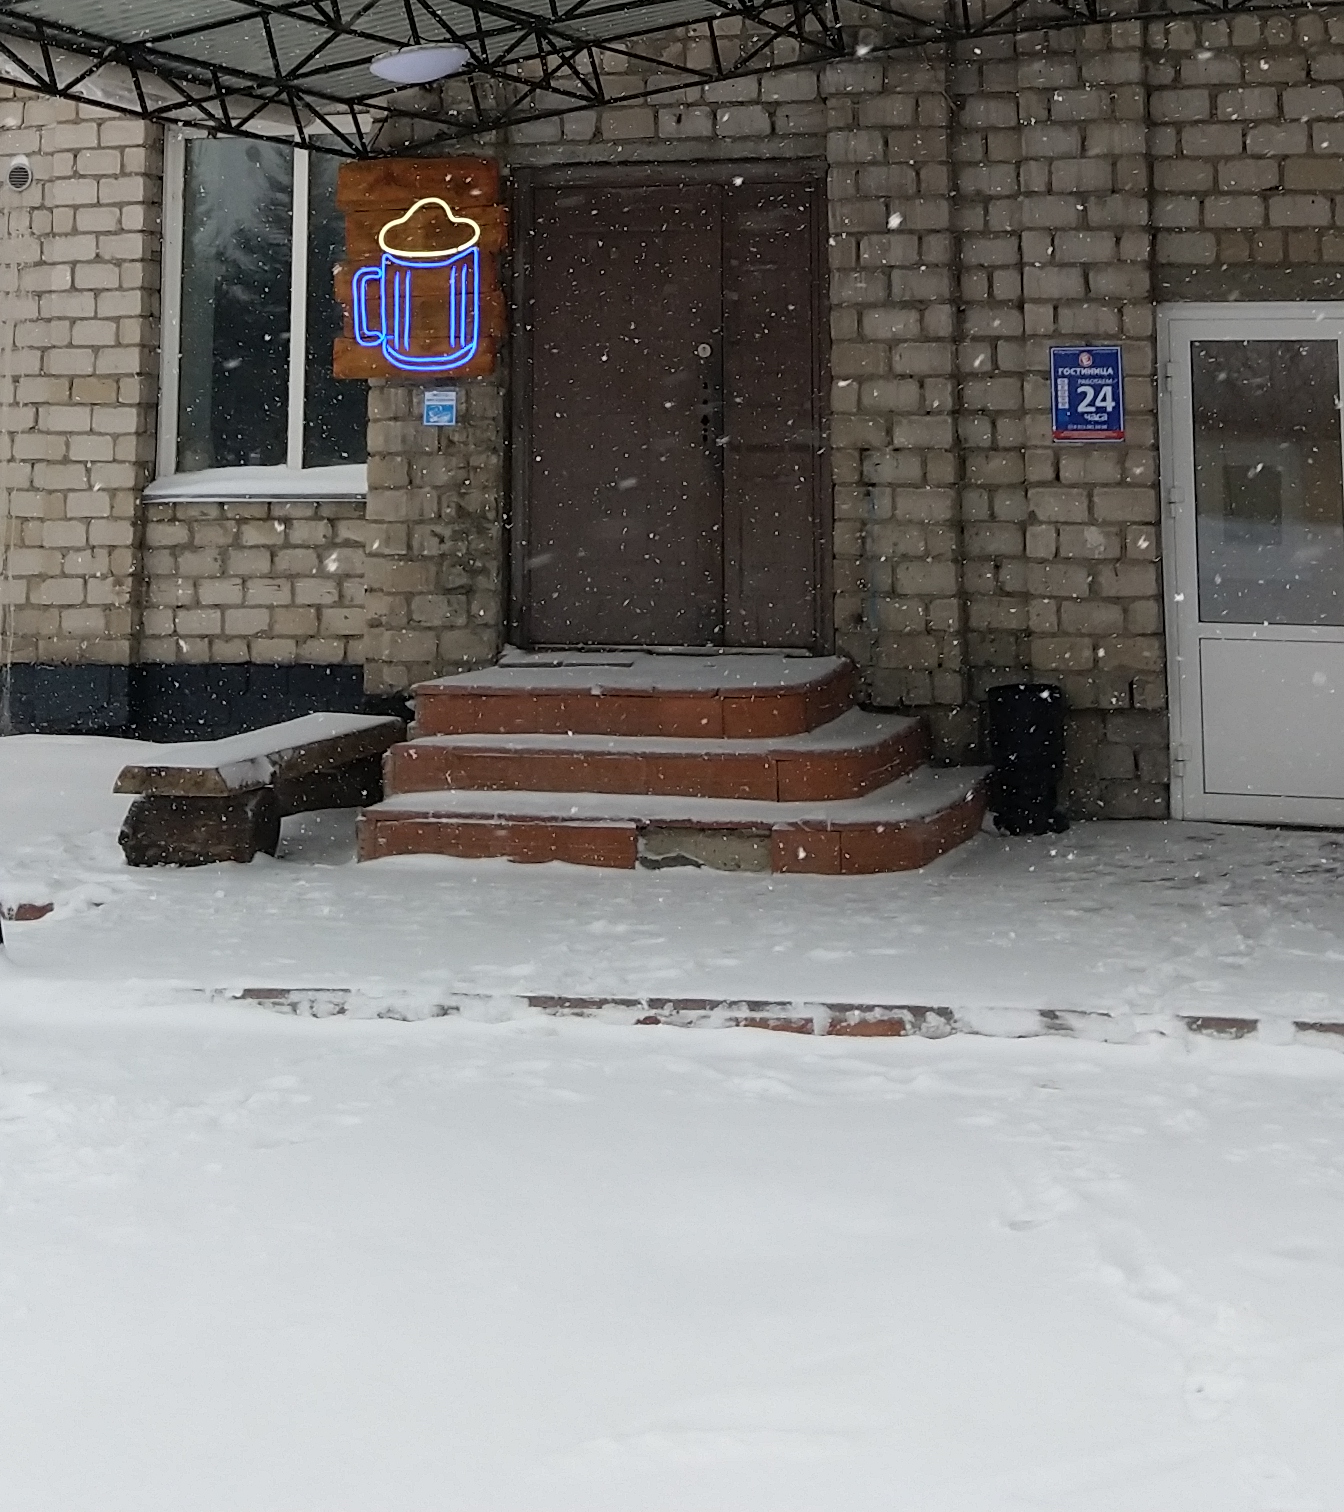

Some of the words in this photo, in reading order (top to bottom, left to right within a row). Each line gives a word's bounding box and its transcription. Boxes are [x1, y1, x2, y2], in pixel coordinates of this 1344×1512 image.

[1058, 367, 1114, 376] ГОСТИНИЦА
[1076, 385, 1116, 413] 24
[1083, 413, 1108, 422] часа
